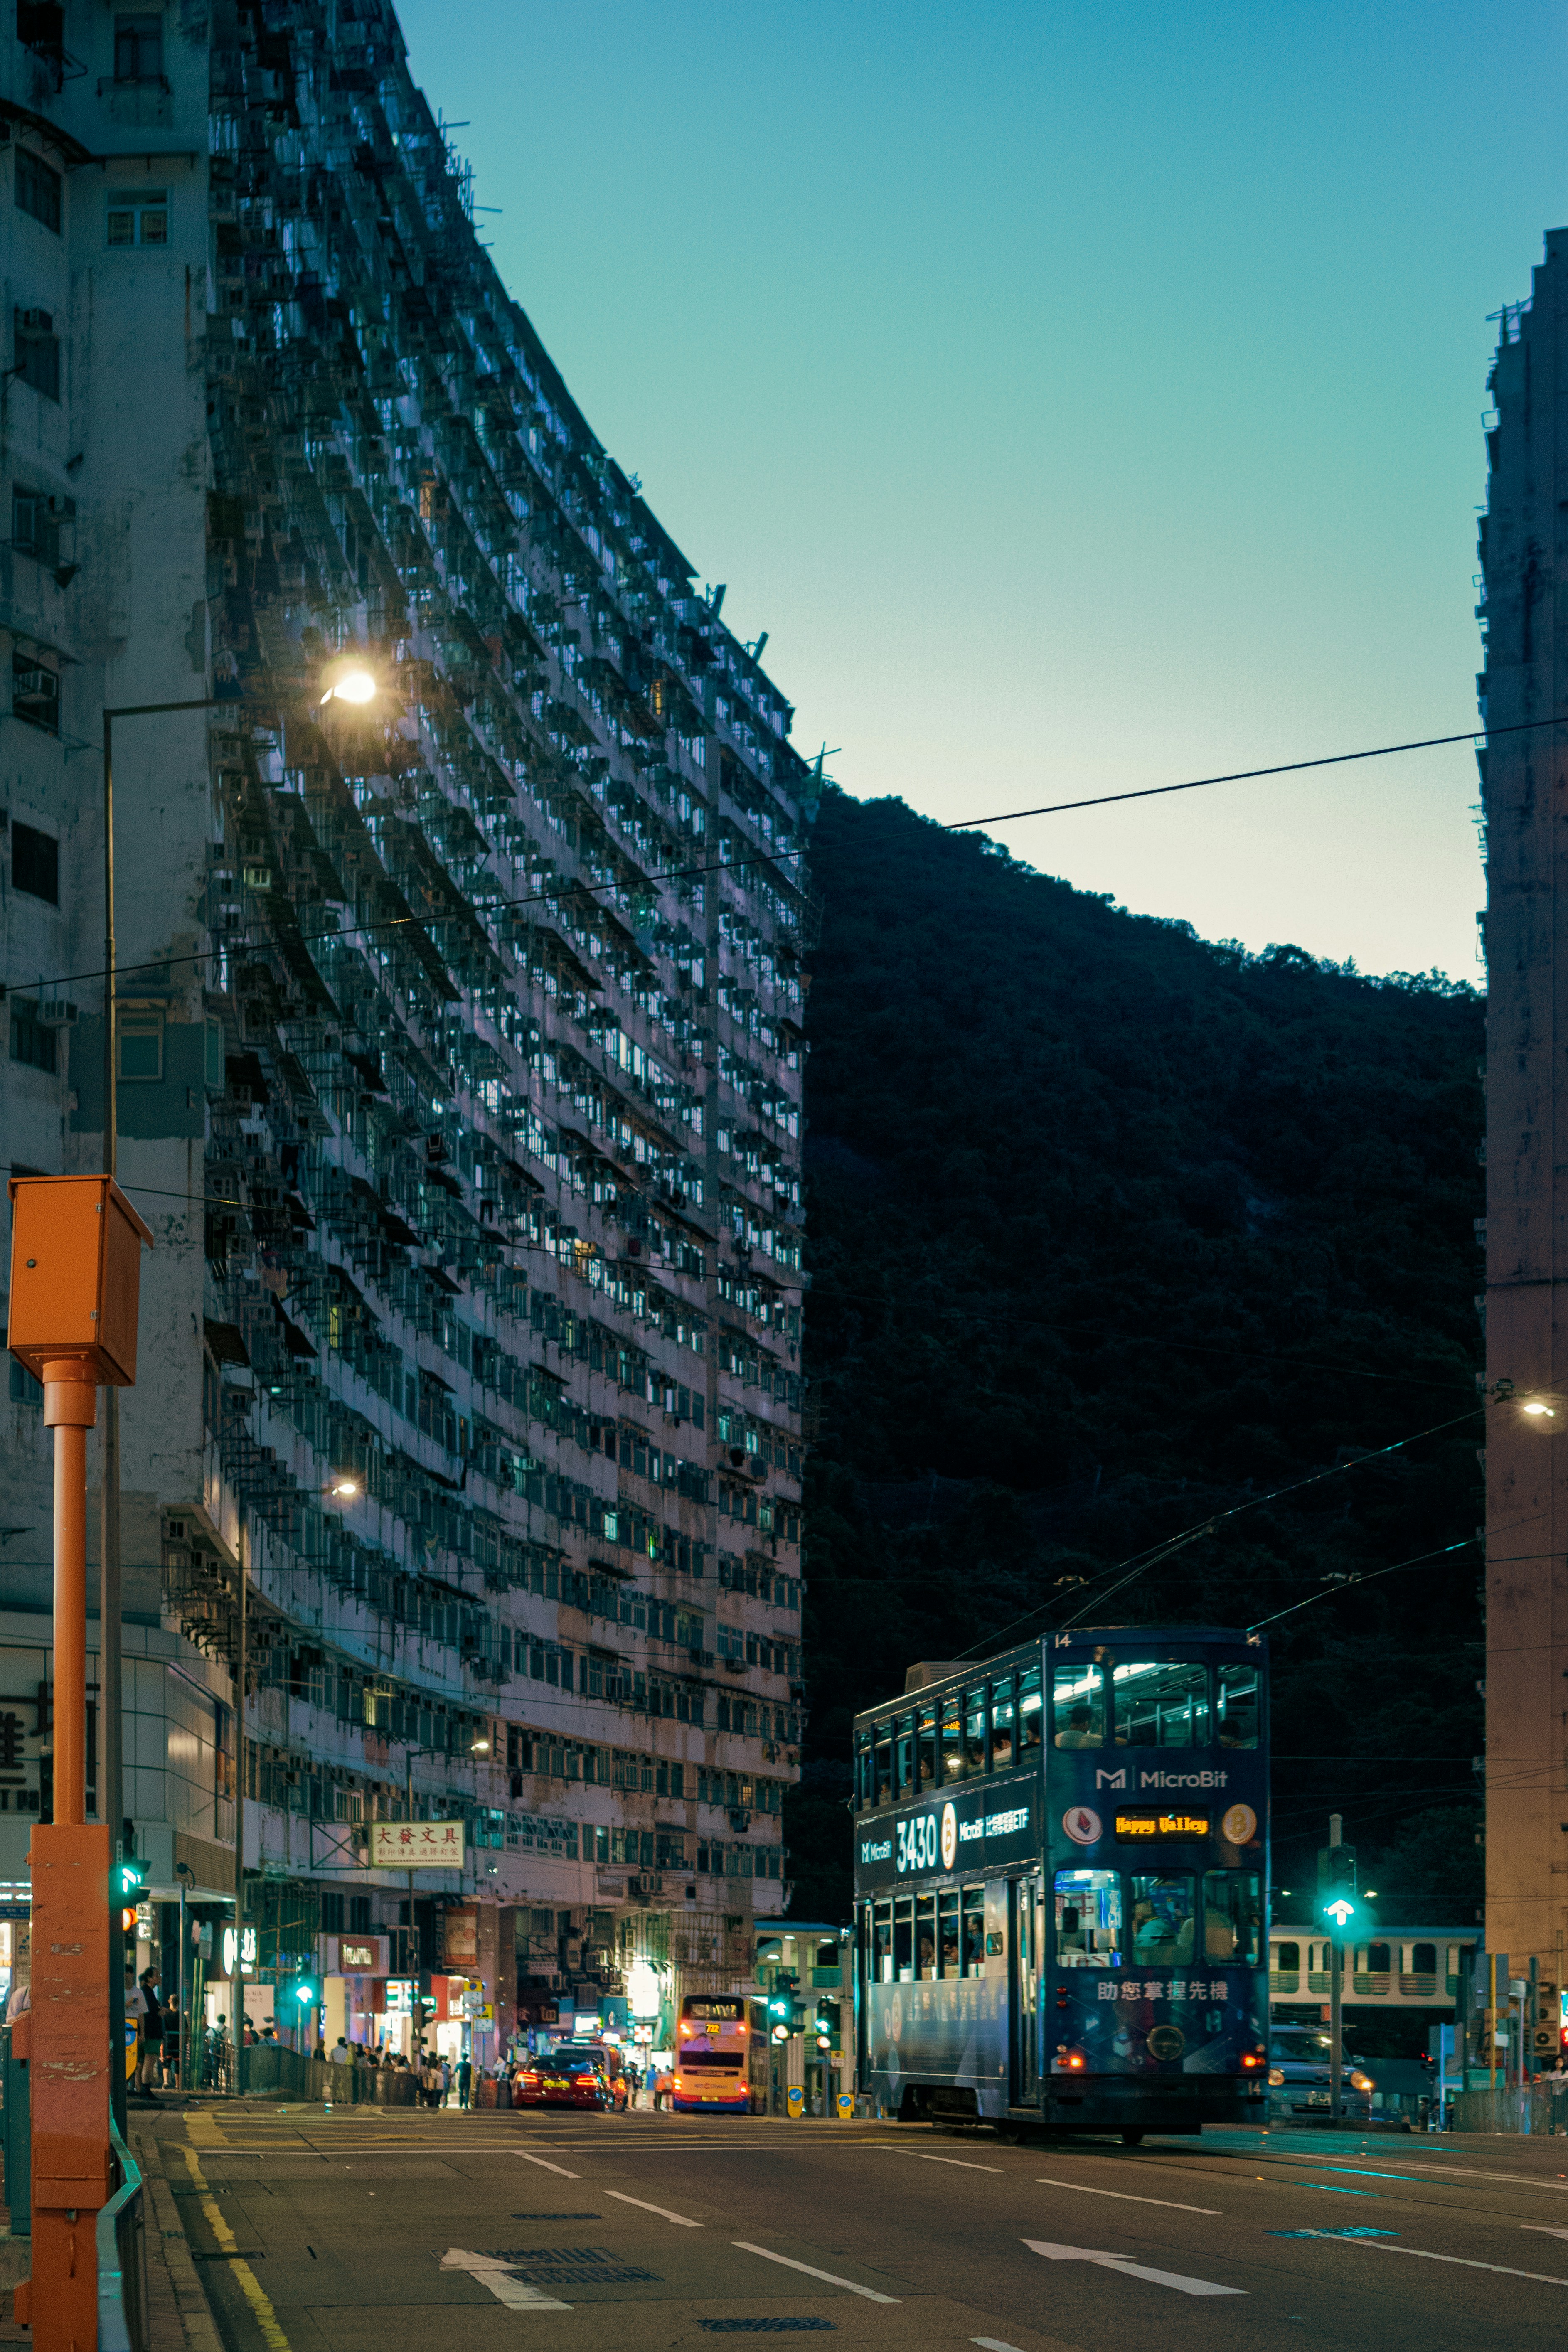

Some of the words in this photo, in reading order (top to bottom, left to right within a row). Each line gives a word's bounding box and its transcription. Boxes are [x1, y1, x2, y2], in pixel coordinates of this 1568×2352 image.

[1055, 1634, 1073, 1648] 14
[1141, 1771, 1228, 1788] MicroBit
[959, 1818, 985, 1841] MicroBit
[1116, 1817, 1156, 1834] Happy
[1159, 1817, 1209, 1834] Valley
[377, 1826, 459, 1845] 大發文具
[896, 1814, 938, 1872] 3430
[871, 1840, 892, 1861] MicroBit
[1098, 1981, 1228, 2001] 助您掌握先機
[706, 2024, 719, 2033] 722
[1247, 2081, 1262, 2096] 14
